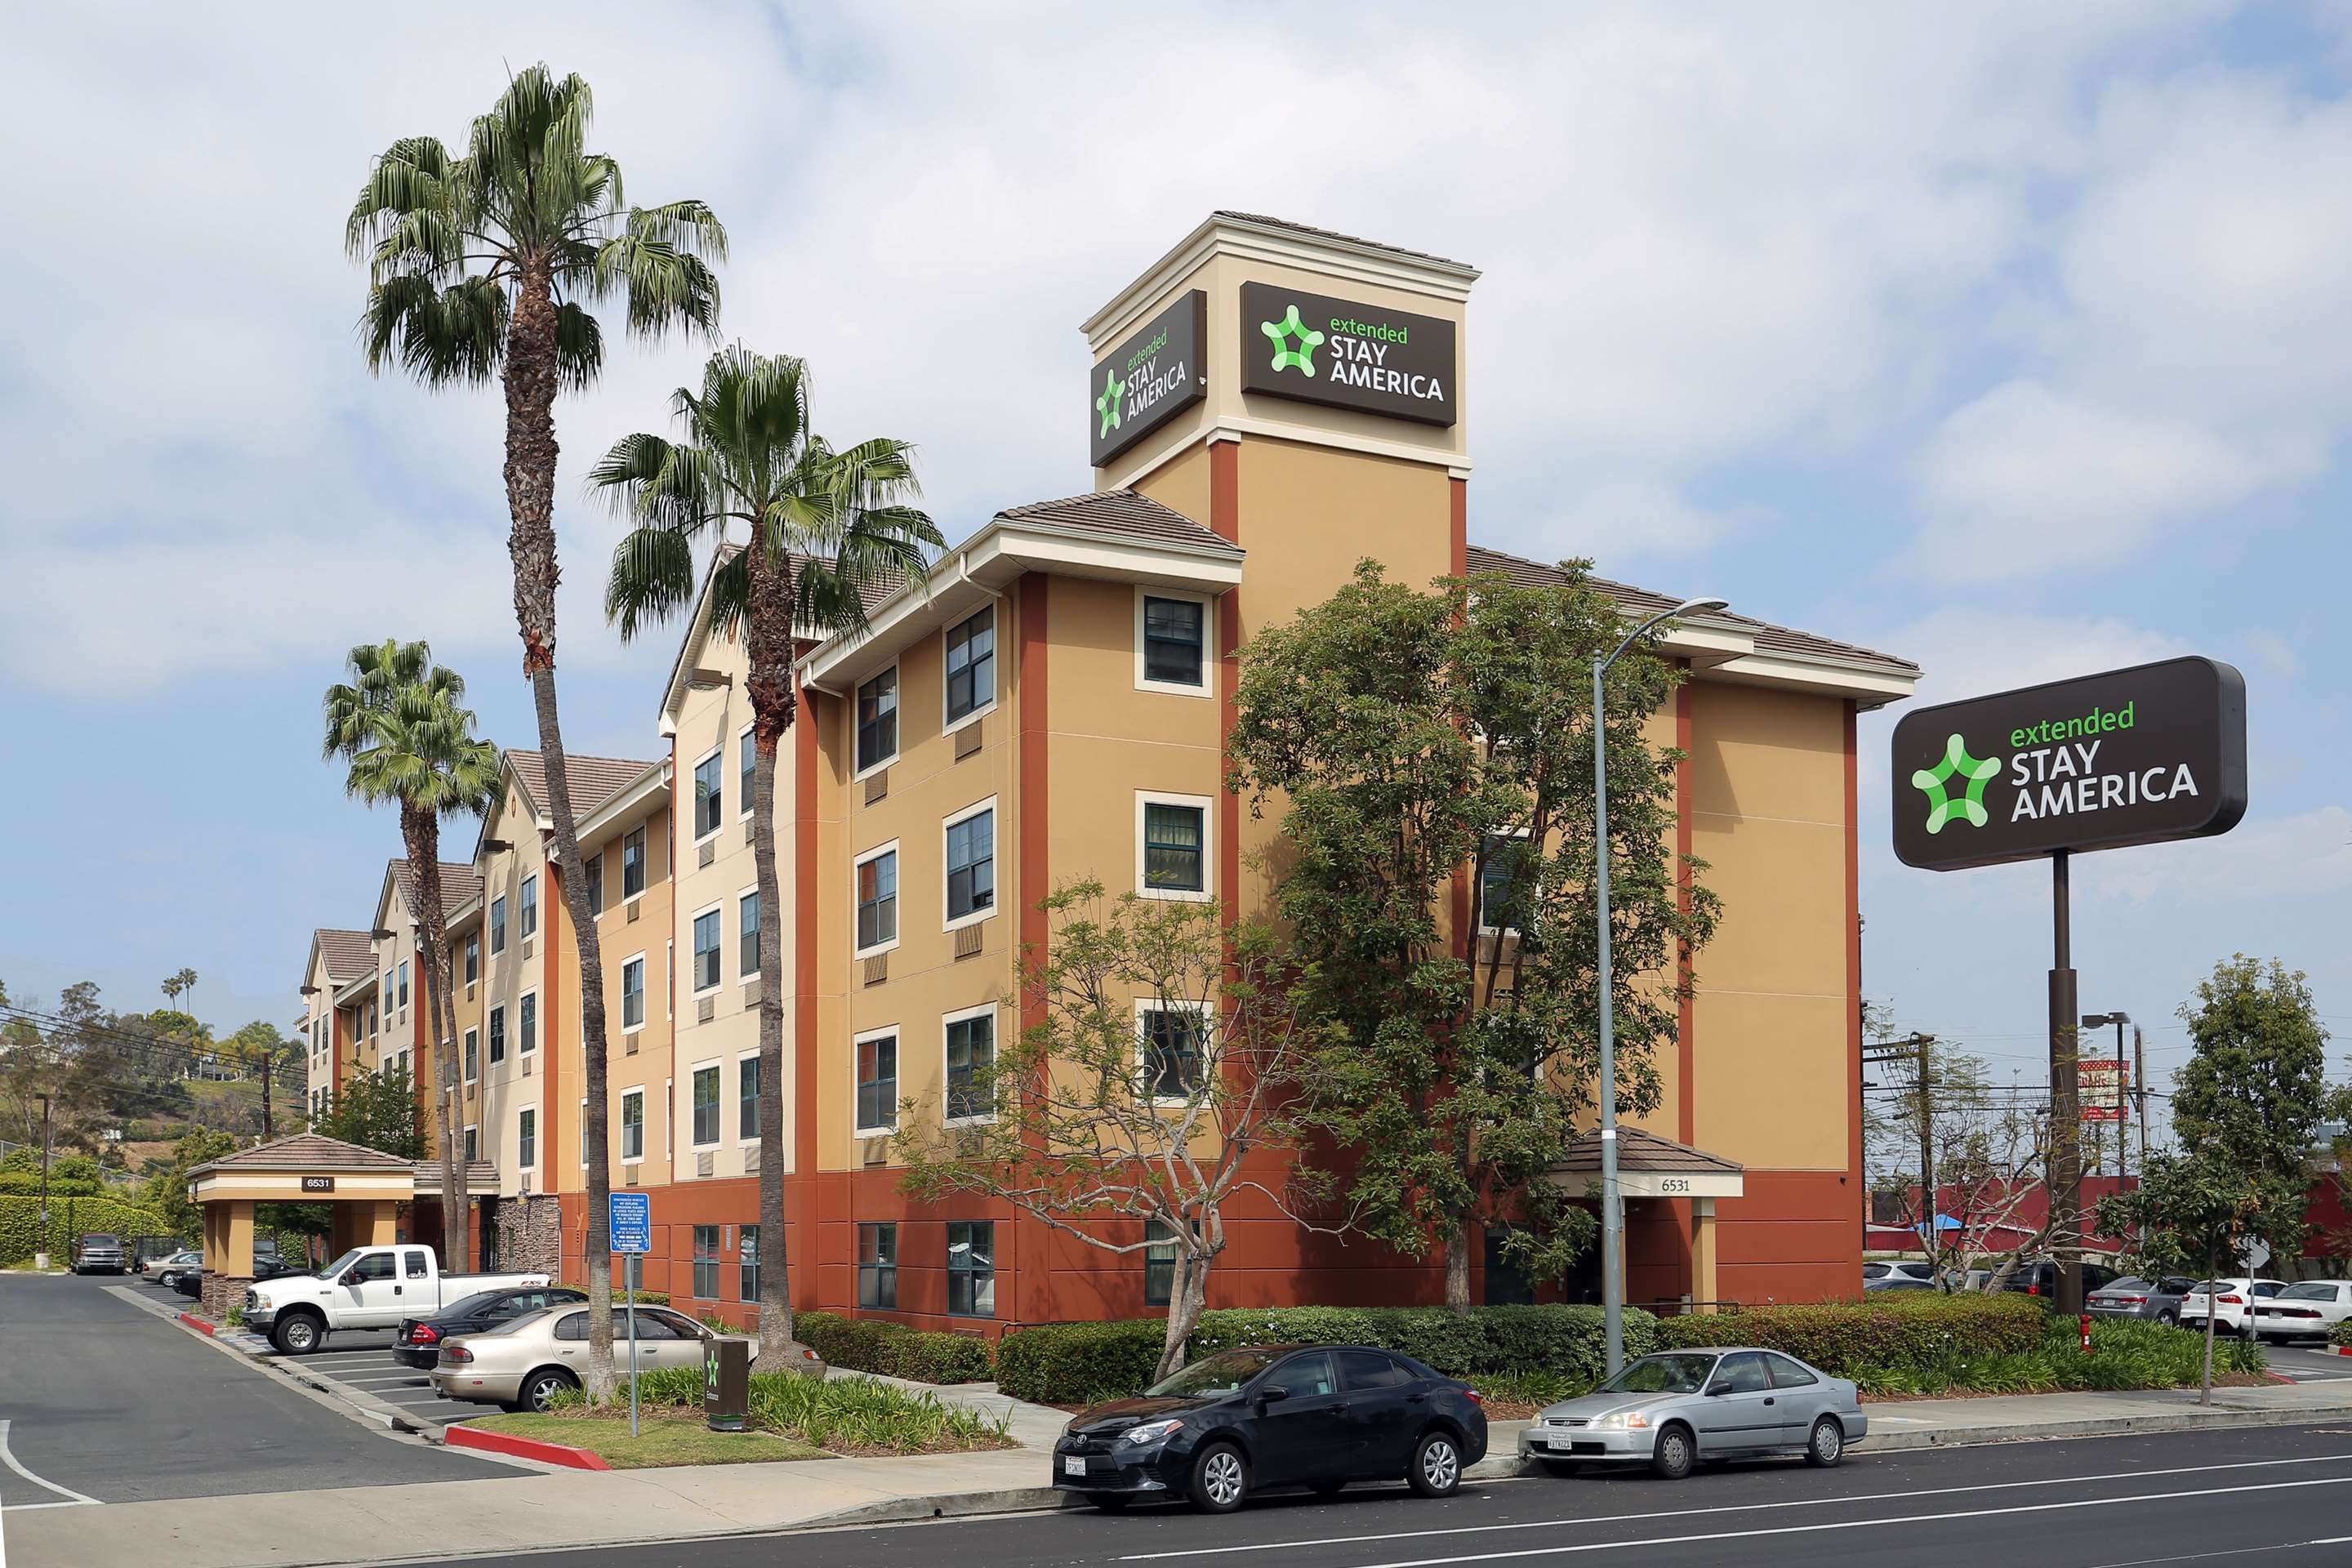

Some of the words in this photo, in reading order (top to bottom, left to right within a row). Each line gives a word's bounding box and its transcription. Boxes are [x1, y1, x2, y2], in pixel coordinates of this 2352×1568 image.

[1127, 327, 1167, 372] extended
[1330, 316, 1408, 345] extended
[1330, 336, 1388, 366] STAY
[1126, 360, 1187, 423] AMERICA
[1127, 356, 1157, 398] STAY
[1330, 360, 1445, 402] AMERICA
[2010, 701, 2135, 748] extended
[2011, 739, 2102, 786] STAY
[2011, 763, 2199, 823] AMERICA
[307, 1178, 329, 1188] 6531
[1662, 1178, 1690, 1192] 6531
